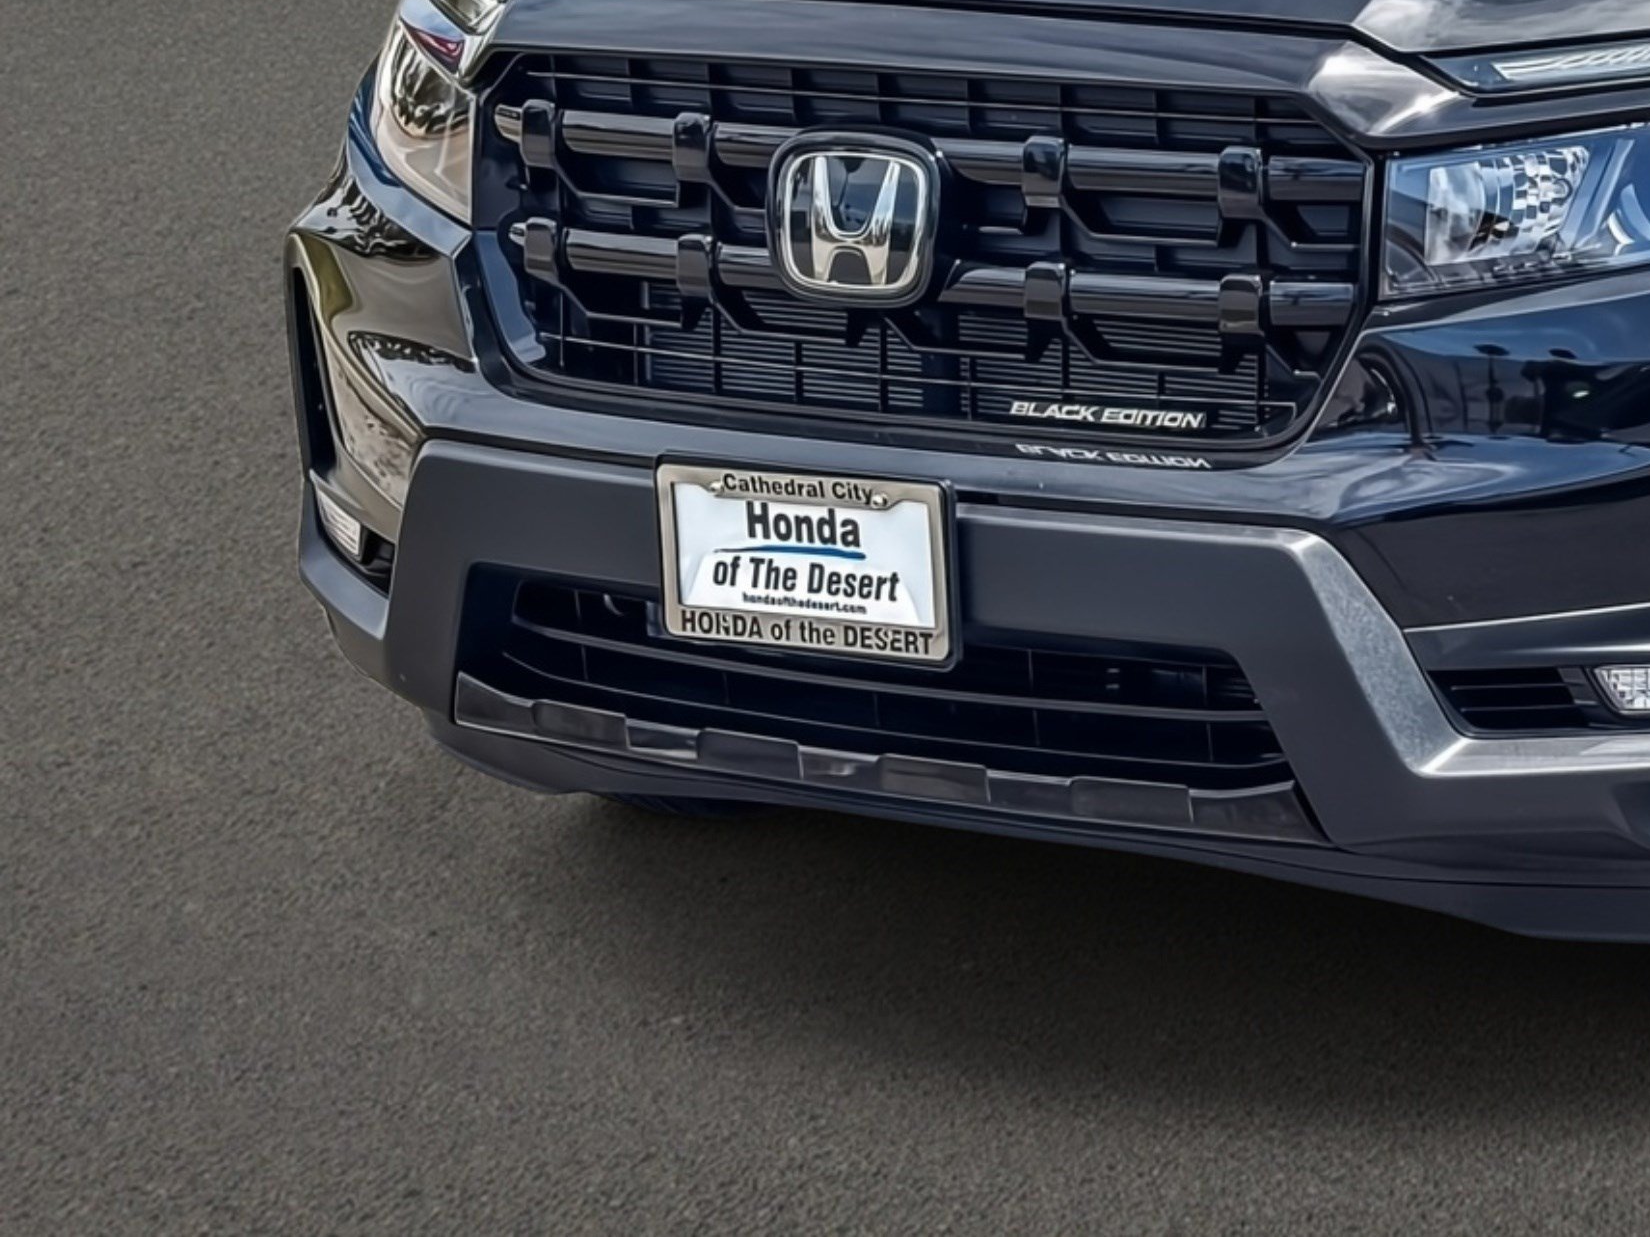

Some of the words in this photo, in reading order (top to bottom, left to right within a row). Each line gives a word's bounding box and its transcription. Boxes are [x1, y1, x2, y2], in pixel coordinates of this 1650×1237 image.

[1009, 400, 1100, 423] BLACK
[1100, 407, 1206, 429] EDITION
[722, 472, 826, 499] Cathedral
[831, 482, 875, 506] City
[745, 500, 861, 548] Honda
[712, 555, 742, 587] of
[748, 557, 797, 592] The
[806, 562, 900, 603] Desert
[680, 609, 764, 639] HONDA
[770, 619, 792, 641] of
[799, 620, 836, 646] the
[843, 624, 934, 655] DESERT
